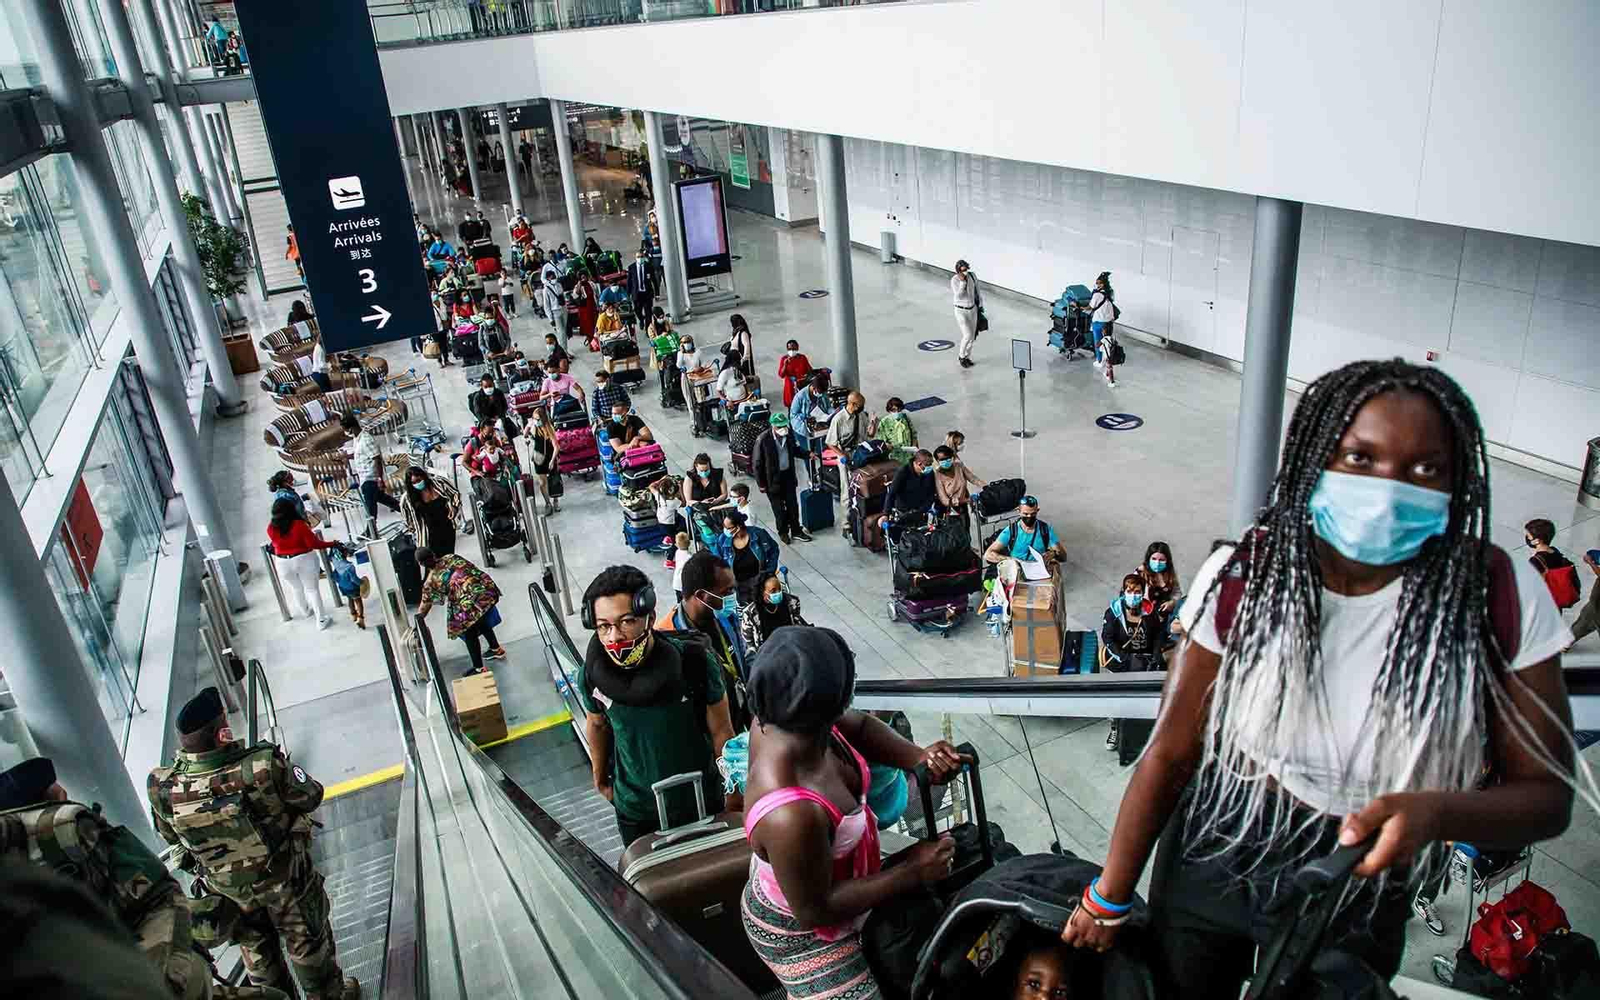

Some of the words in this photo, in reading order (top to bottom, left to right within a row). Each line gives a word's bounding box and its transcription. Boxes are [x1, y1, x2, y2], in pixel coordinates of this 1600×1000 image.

[329, 217, 381, 233] Arrivées
[334, 230, 382, 248] Arrivals
[349, 248, 372, 260] 到达
[359, 268, 377, 293] 3
